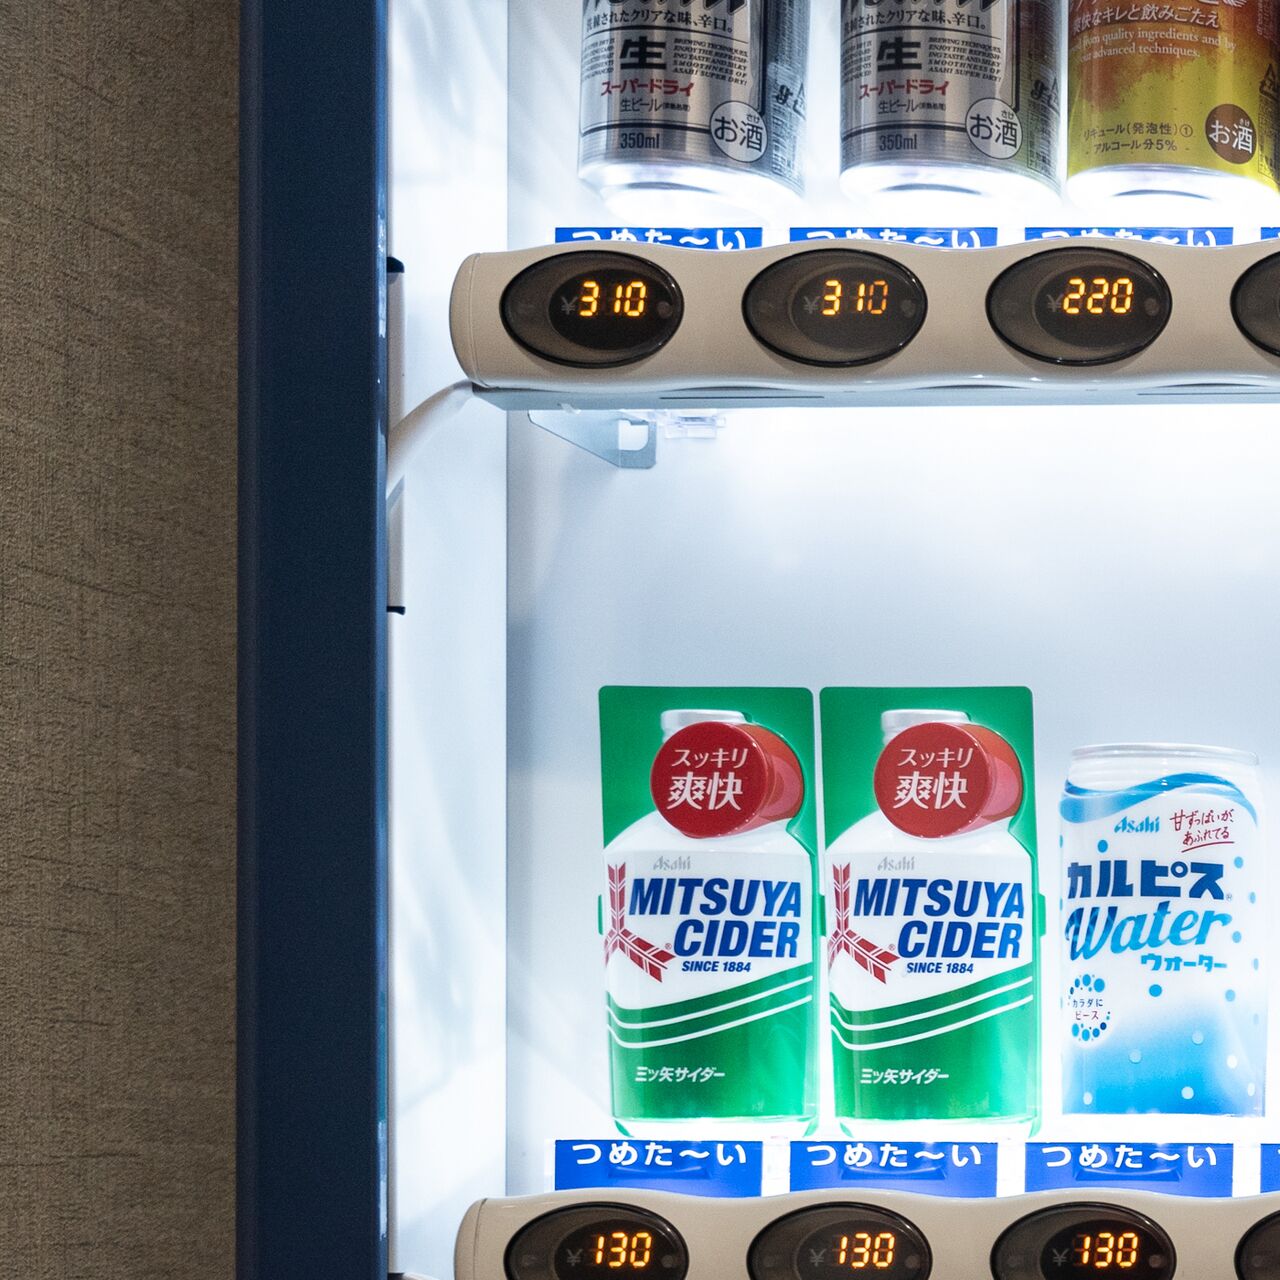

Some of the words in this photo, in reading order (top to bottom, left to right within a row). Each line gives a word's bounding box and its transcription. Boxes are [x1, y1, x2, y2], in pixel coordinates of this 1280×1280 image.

[620, 36, 667, 70] 生
[877, 37, 922, 71] 生
[601, 79, 694, 96] スーパードライ
[859, 80, 949, 99] スーパードライ
[620, 133, 659, 149] 350ml
[714, 116, 763, 152] お酒
[880, 134, 917, 150] 350ml
[969, 114, 1018, 148] お酒
[1209, 120, 1253, 153] お酒
[672, 748, 748, 769] スッキリ
[898, 747, 973, 768] スッキリ
[667, 771, 743, 811] 爽快
[893, 771, 968, 809] 爽快
[1114, 816, 1160, 833] Asahi
[1183, 826, 1230, 846] あふれてる
[1067, 860, 1224, 900] カルピス
[629, 878, 800, 917] MITSUYA
[854, 879, 1024, 918] MITSUYA
[674, 919, 800, 958] CIDER
[898, 920, 1022, 959] CIDER
[1064, 901, 1232, 961] Water
[682, 961, 719, 972] SINCE
[723, 962, 751, 973] 1884
[907, 963, 942, 974] SINCE
[947, 963, 974, 974] 1884
[1073, 999, 1103, 1008] カラダに
[635, 1066, 725, 1082] 三ツ矢サイダー
[861, 1068, 949, 1084] 三ツ矢サイダー
